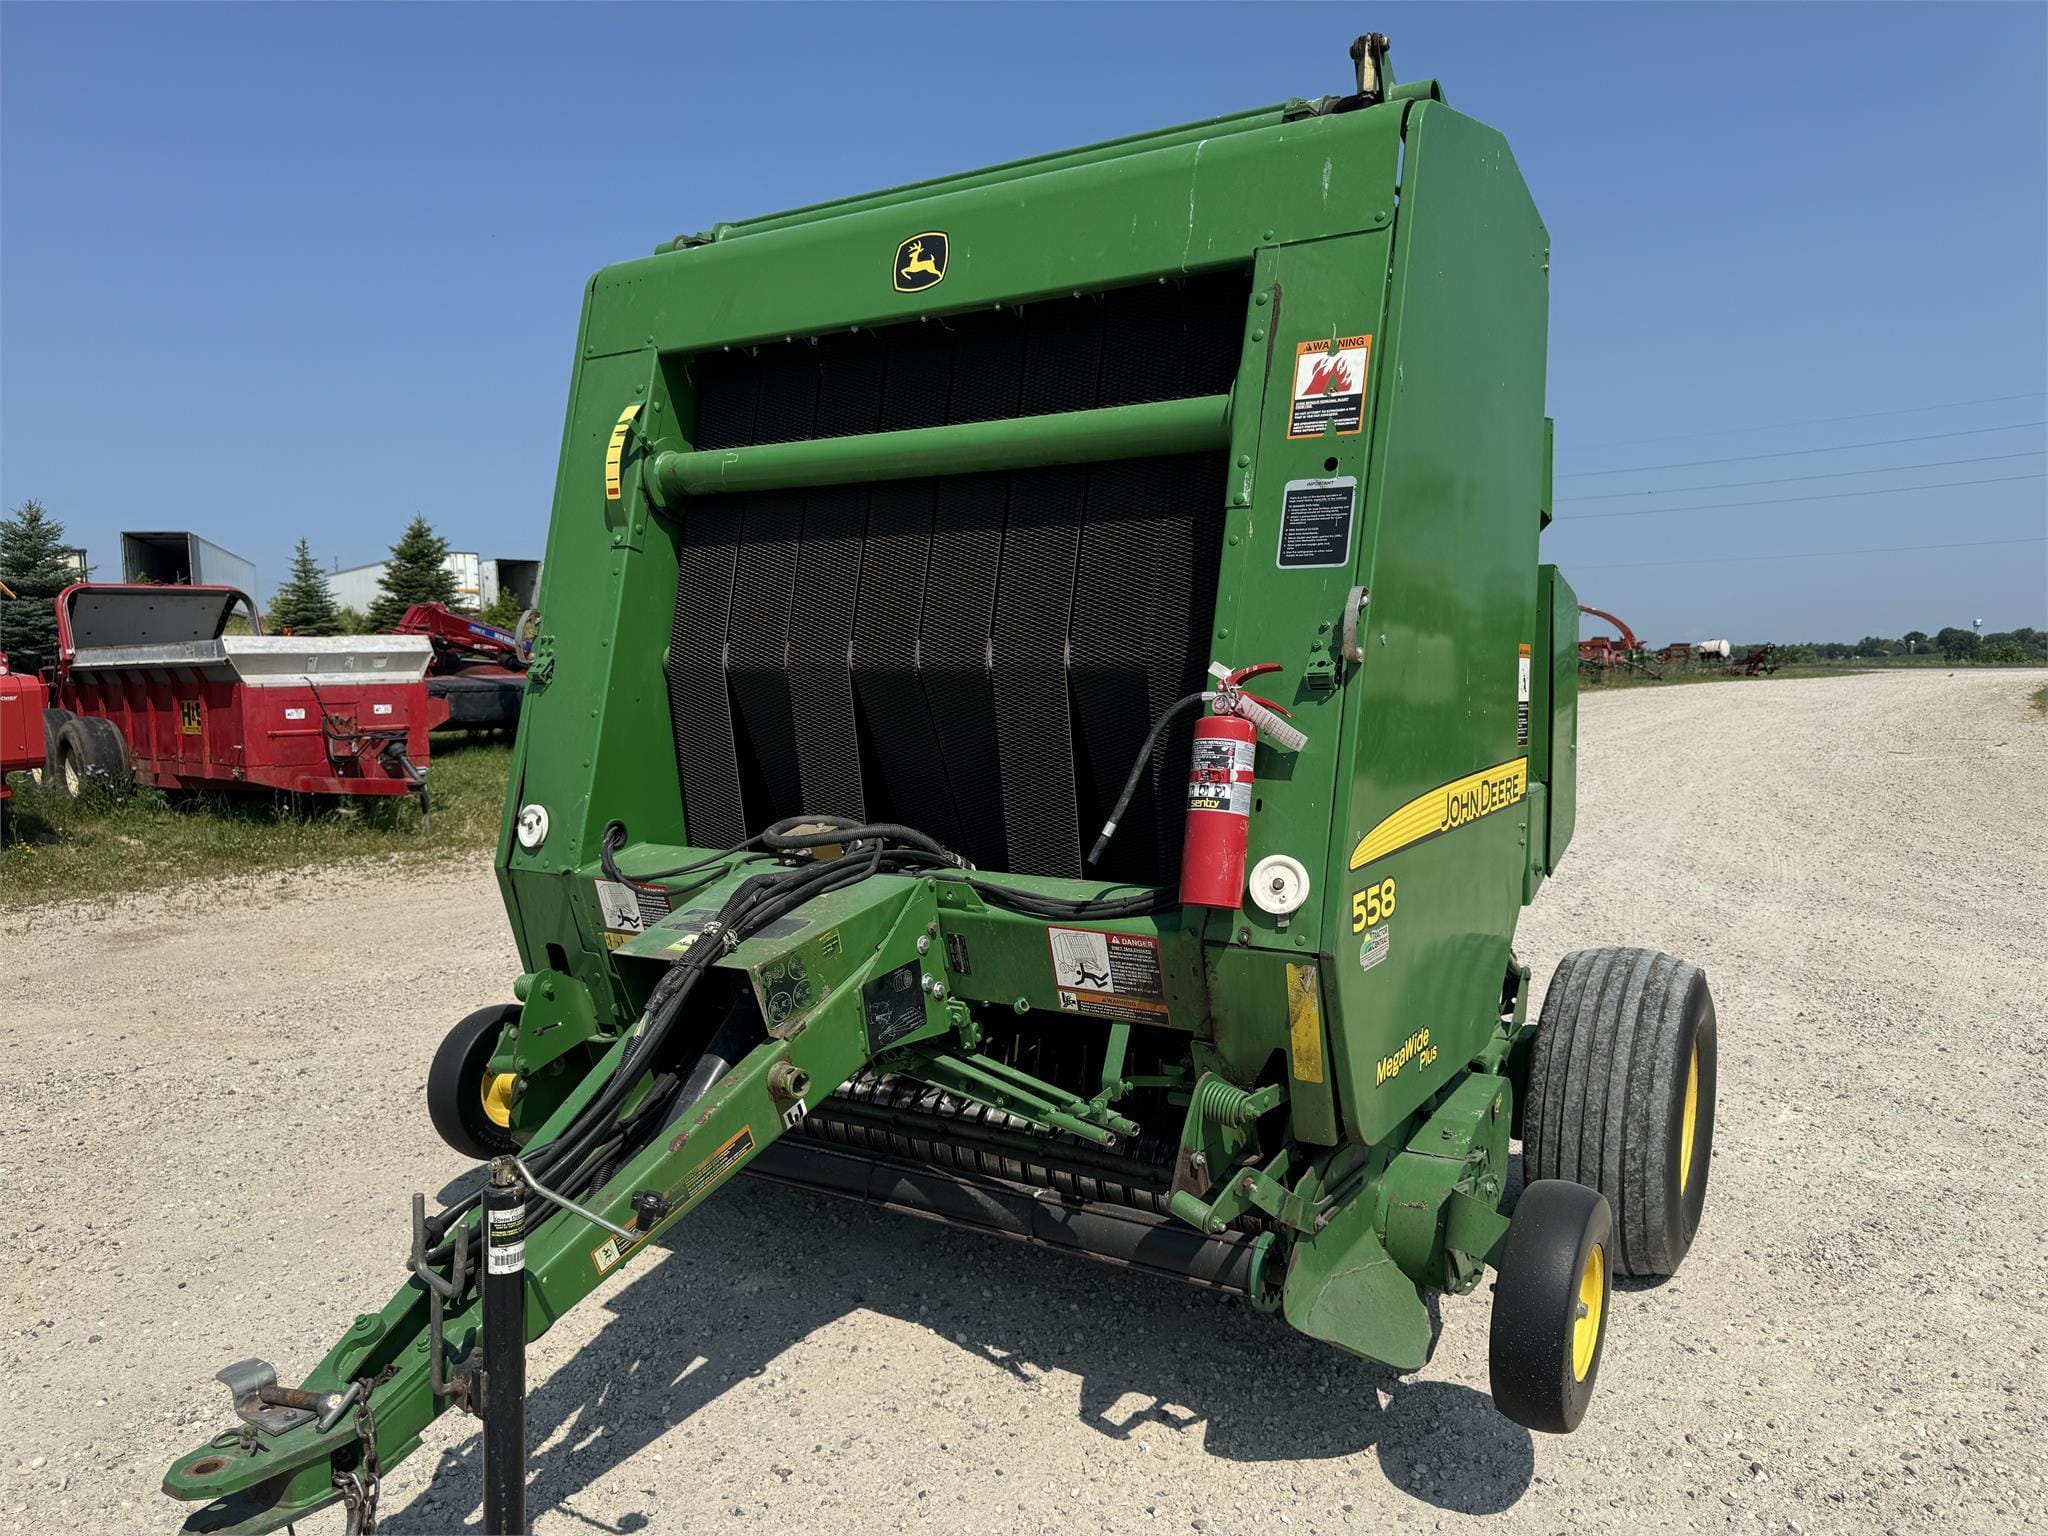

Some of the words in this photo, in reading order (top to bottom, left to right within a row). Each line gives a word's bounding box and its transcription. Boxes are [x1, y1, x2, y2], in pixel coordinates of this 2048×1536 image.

[1313, 337, 1364, 350] WANING
[1190, 798, 1220, 809] sentry
[1441, 788, 1479, 828] JOHN
[1481, 774, 1519, 812] DEERE
[1352, 877, 1396, 934] 558
[1121, 938, 1154, 948] DANGER
[1106, 997, 1137, 1007] WARNING
[1376, 1026, 1430, 1087] MegaWide
[1419, 1045, 1438, 1072] Plus
